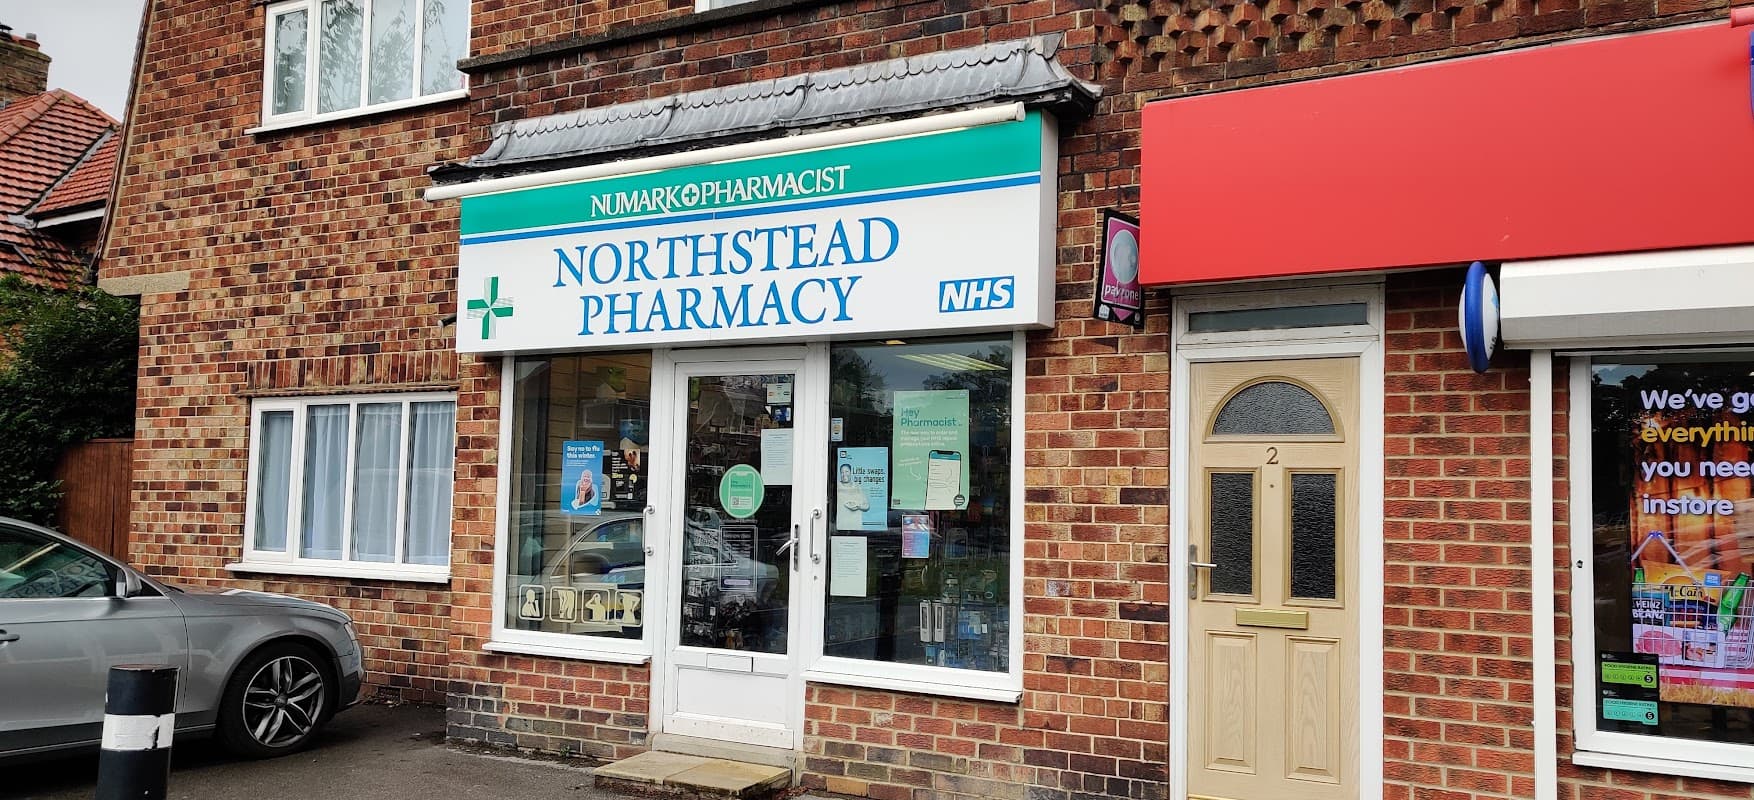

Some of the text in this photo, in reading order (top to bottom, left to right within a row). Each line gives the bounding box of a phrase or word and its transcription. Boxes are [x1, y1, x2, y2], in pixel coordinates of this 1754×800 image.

[590, 165, 851, 217] NUMARK PHARMACIST
[553, 216, 900, 288] NORTHSTEAD
[941, 278, 1013, 311] NHS
[578, 276, 863, 336] PHARMACY
[1640, 388, 1724, 410] We've
[901, 408, 920, 419] Hey
[1266, 446, 1279, 465] 2
[852, 466, 866, 475] Little
[863, 476, 885, 485] changes
[1641, 461, 1754, 482] you nee
[1642, 493, 1735, 516] instore
[1635, 599, 1662, 609] HEINZ
